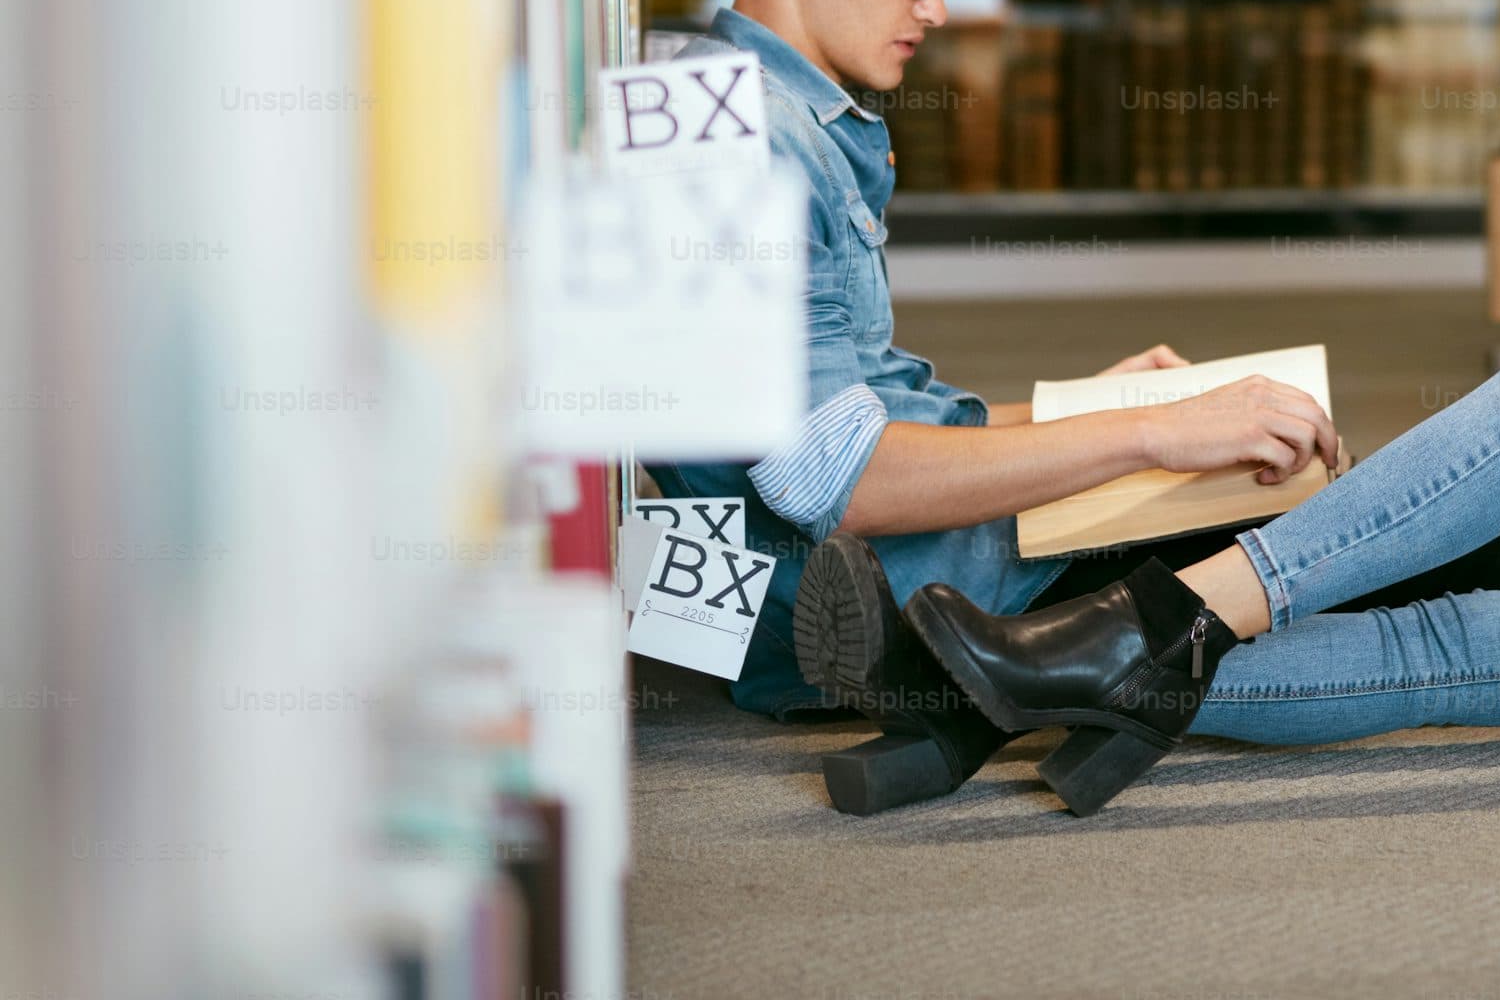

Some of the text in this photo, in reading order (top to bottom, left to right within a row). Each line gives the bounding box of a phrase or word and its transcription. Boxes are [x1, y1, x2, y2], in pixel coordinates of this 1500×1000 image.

[611, 66, 757, 151] BX
[649, 534, 770, 618] BX
[680, 605, 716, 625] 2205
